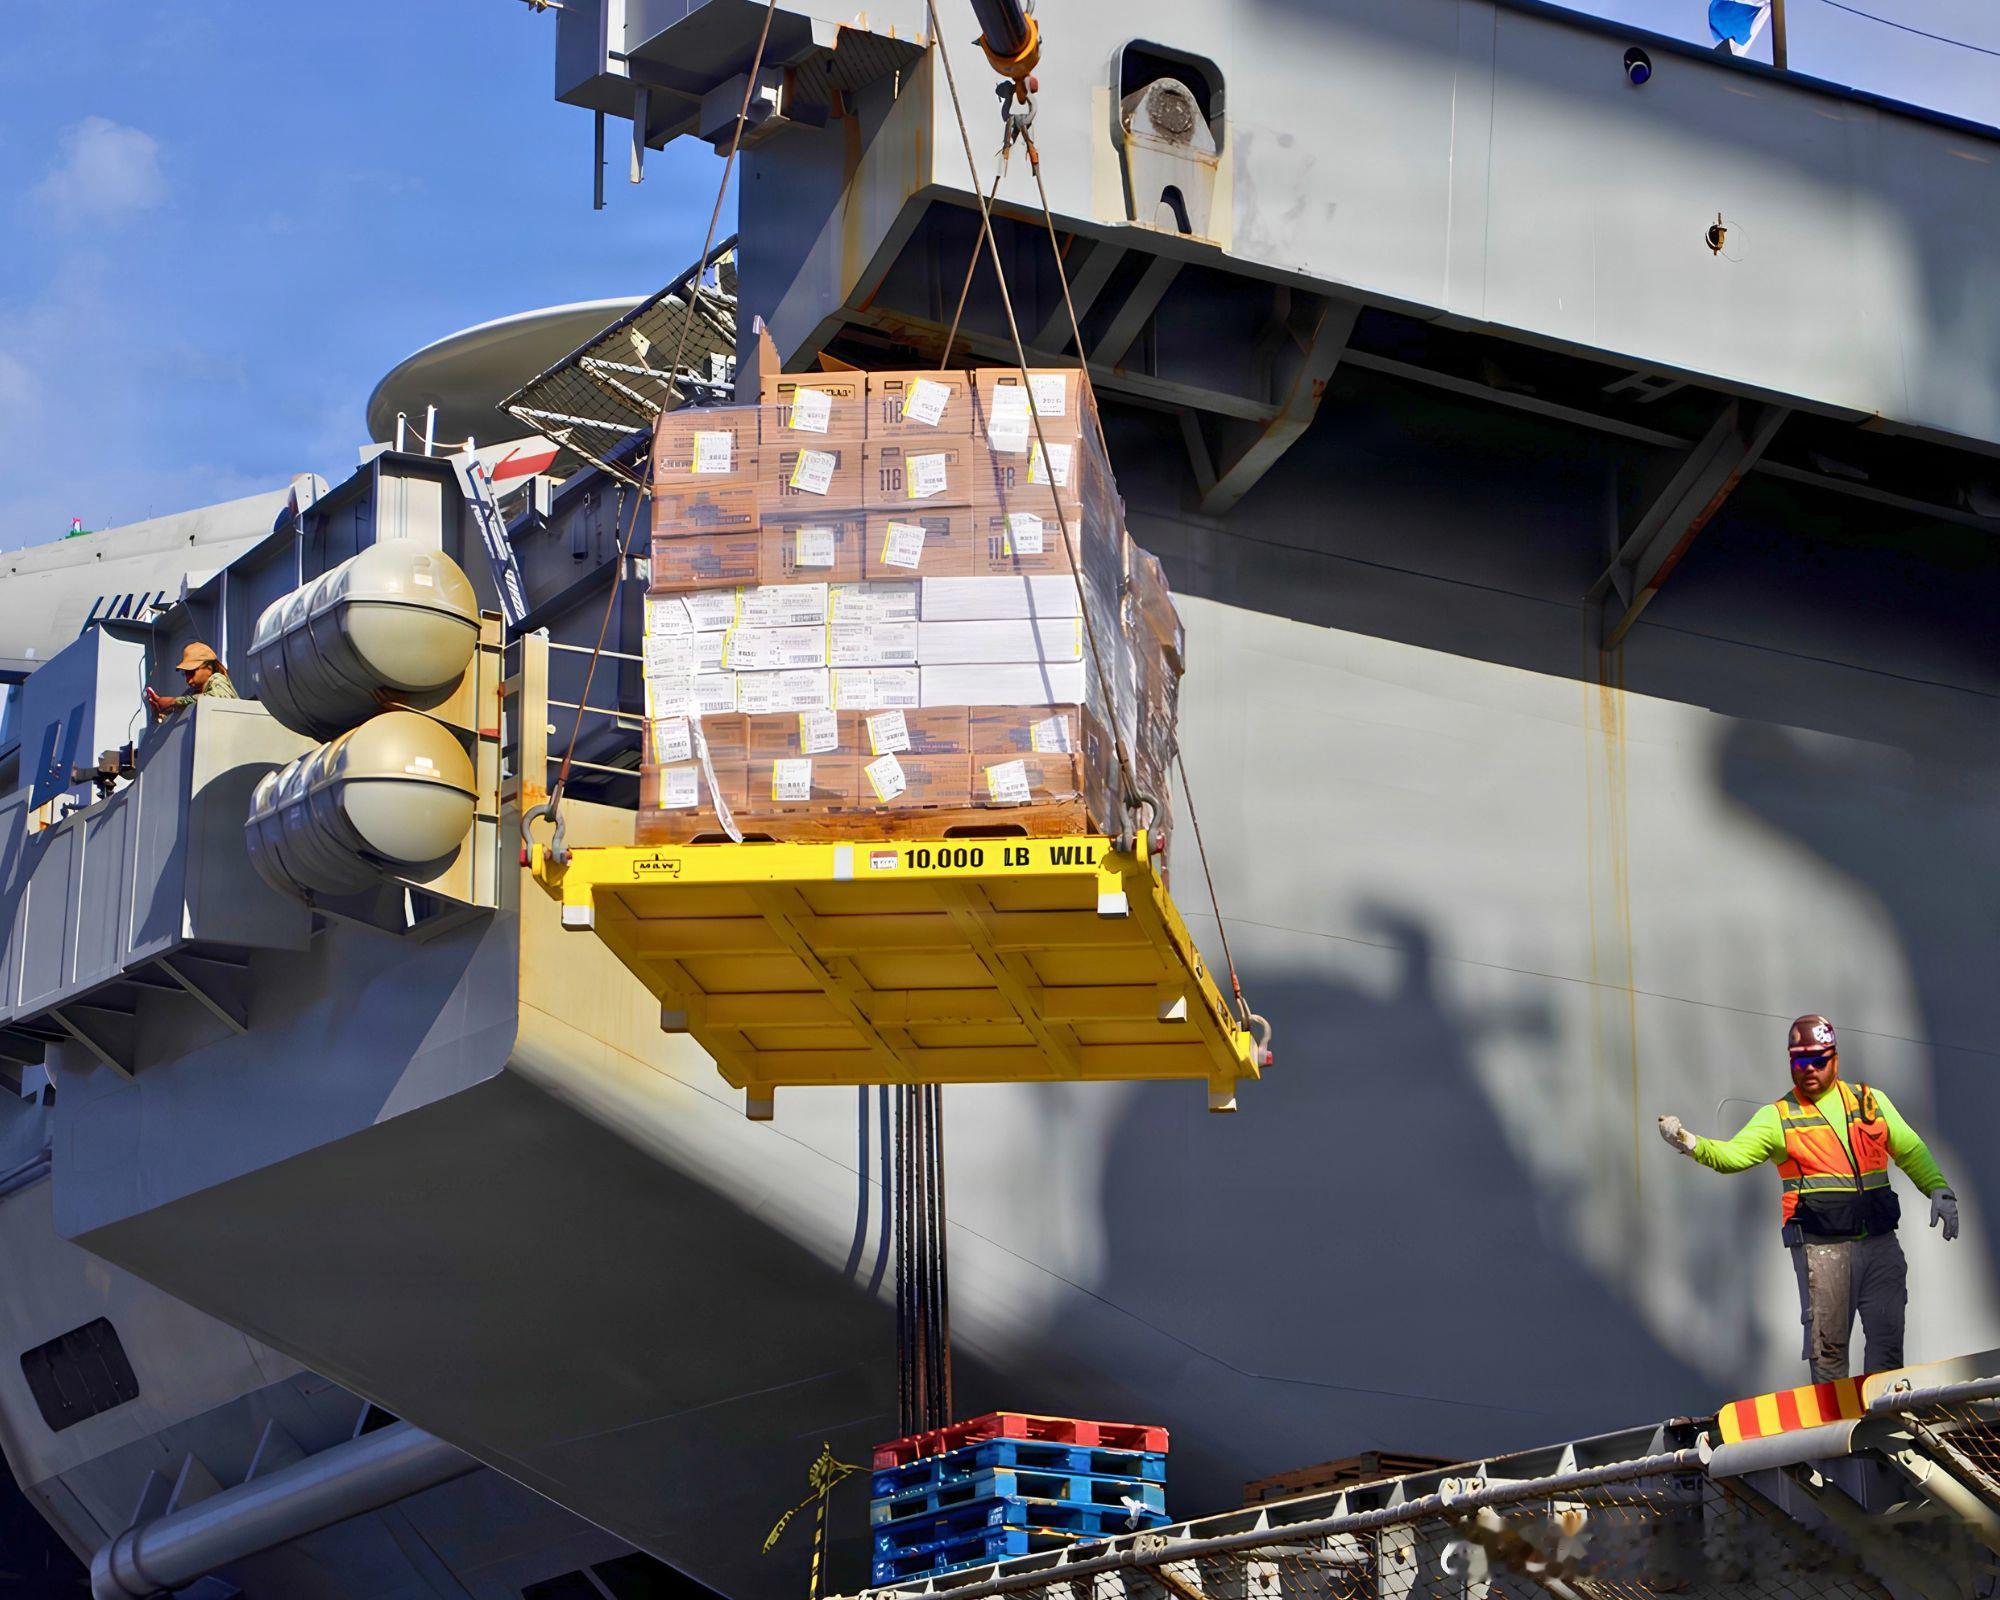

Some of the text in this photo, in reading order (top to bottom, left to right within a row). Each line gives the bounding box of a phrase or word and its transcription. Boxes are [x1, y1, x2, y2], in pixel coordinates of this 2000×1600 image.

[905, 848, 984, 870] 10,000
[1004, 847, 1030, 867] LB
[1050, 846, 1097, 866] WLL
